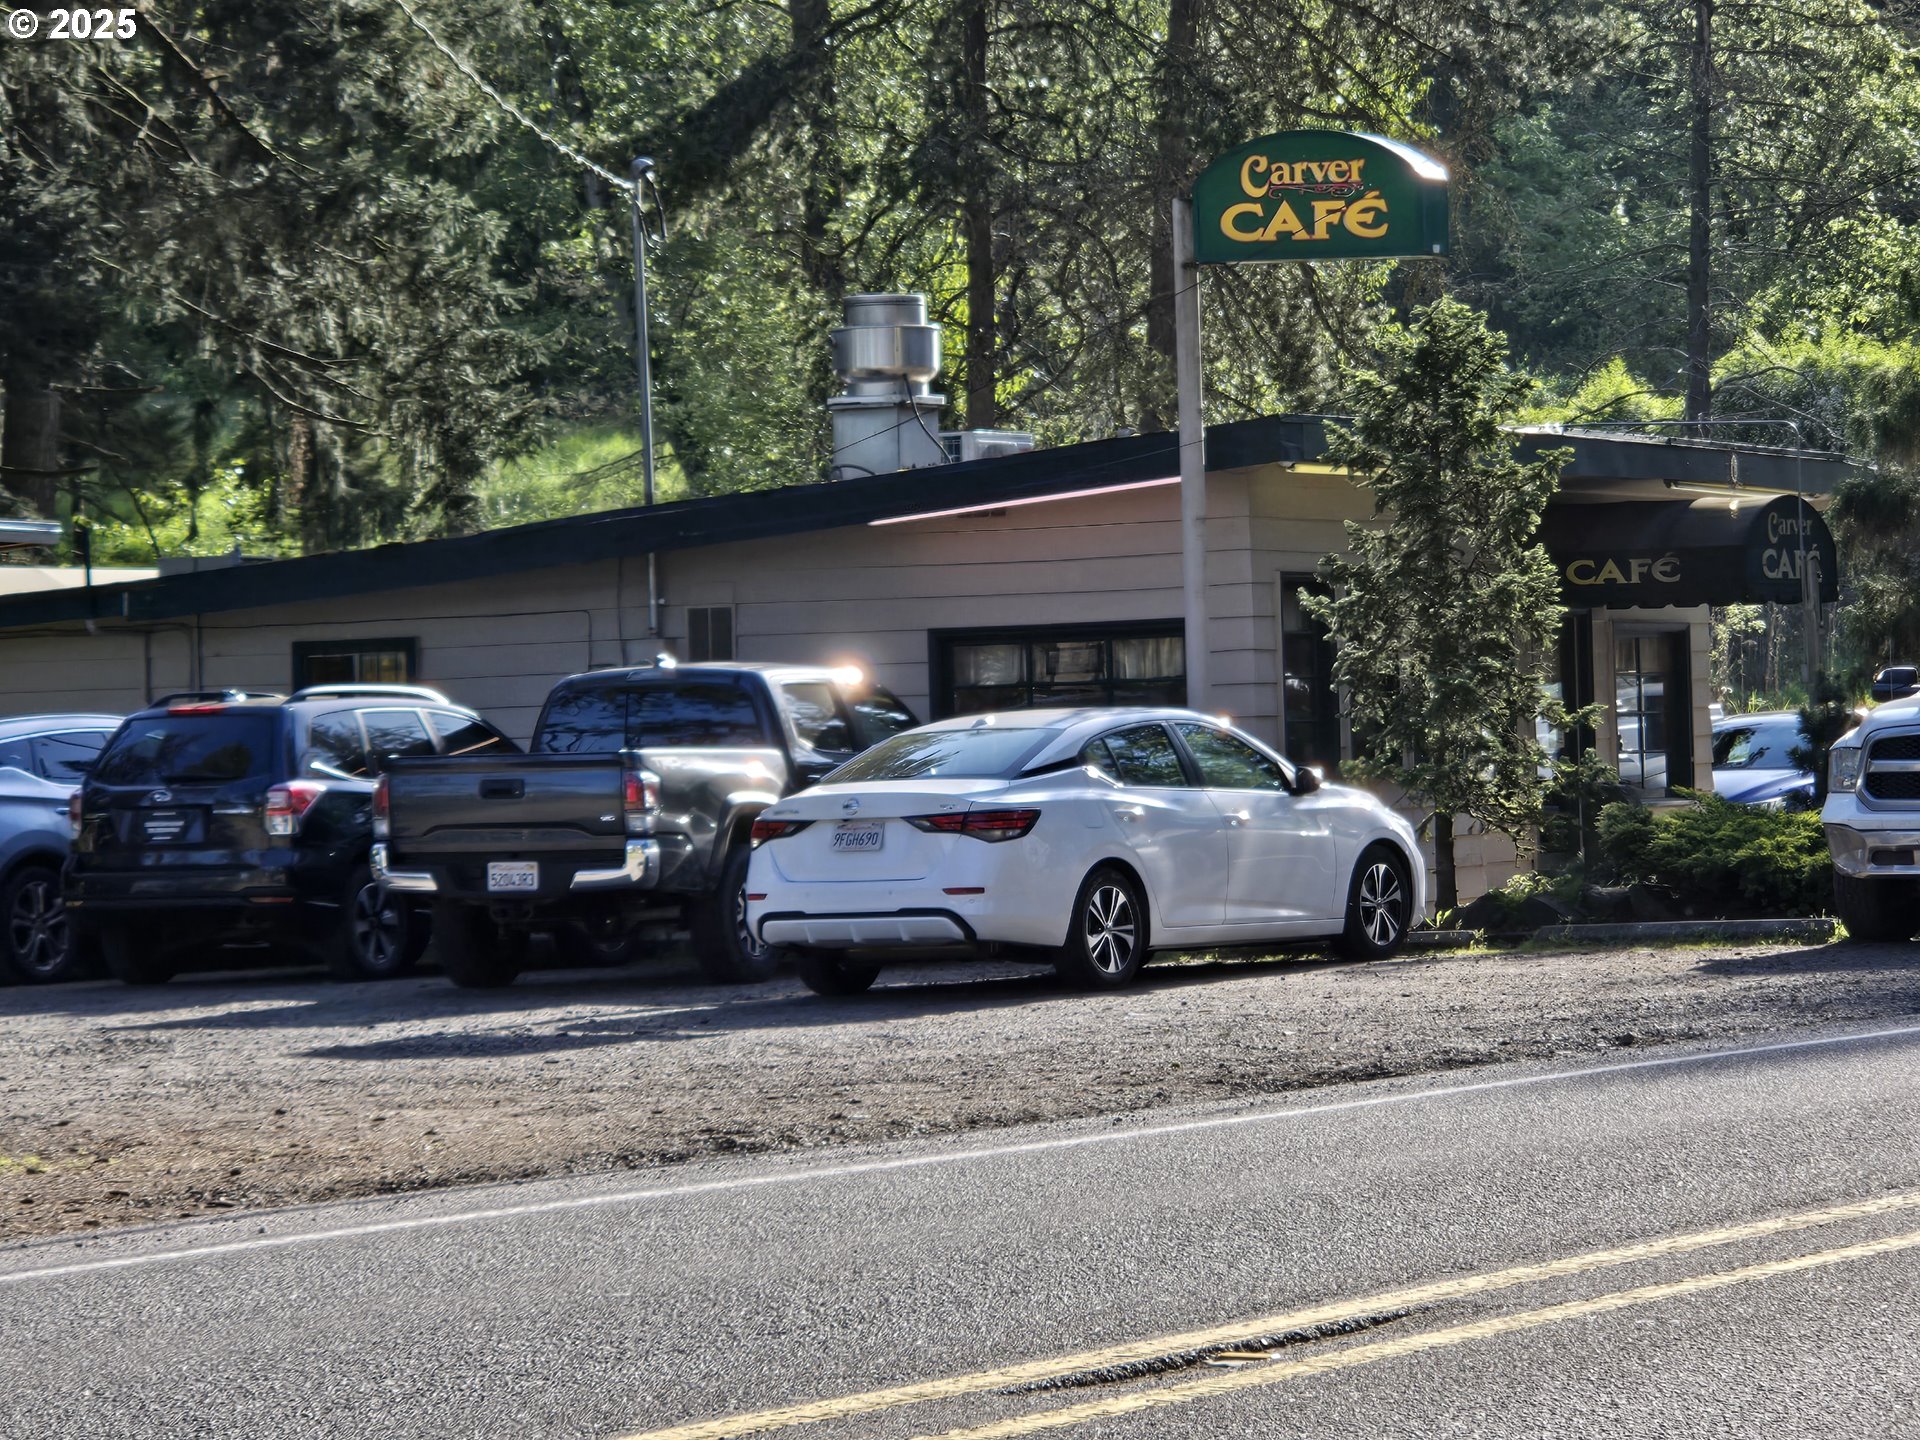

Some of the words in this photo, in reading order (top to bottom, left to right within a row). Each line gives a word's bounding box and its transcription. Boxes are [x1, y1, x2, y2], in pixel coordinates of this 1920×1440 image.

[1240, 155, 1366, 198] Carver
[1220, 190, 1389, 242] CAFÉ
[1565, 552, 1681, 585] CAFÉ
[833, 831, 879, 847] 9FGH690
